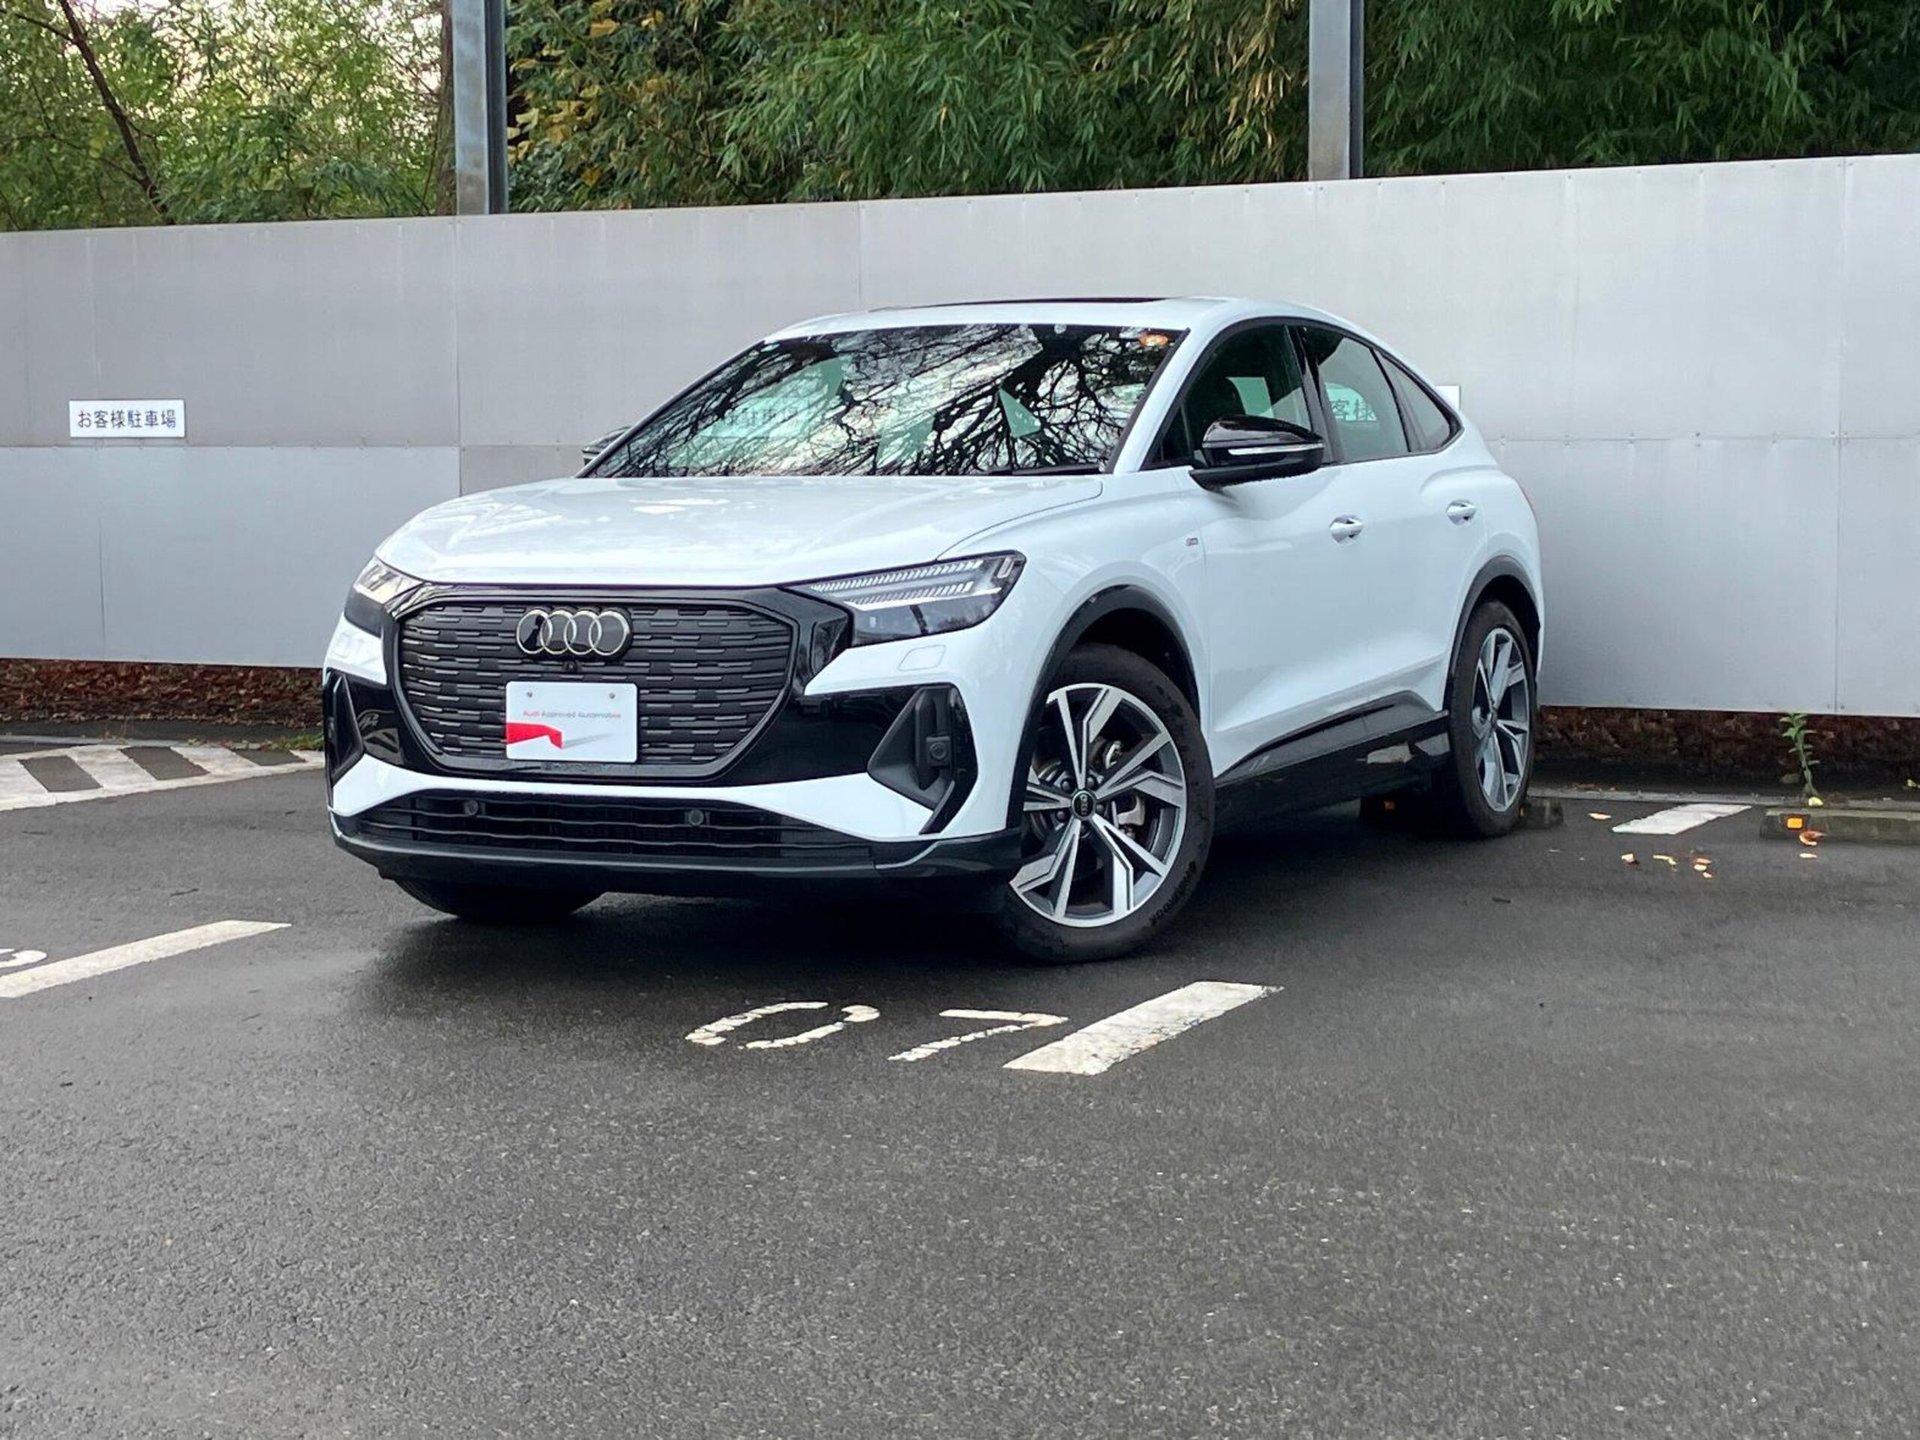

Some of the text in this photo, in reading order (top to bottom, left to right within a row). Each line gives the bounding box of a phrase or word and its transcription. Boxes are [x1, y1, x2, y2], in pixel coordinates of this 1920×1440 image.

[78, 410, 176, 428] お客様駐車場
[542, 711, 576, 719] Approved
